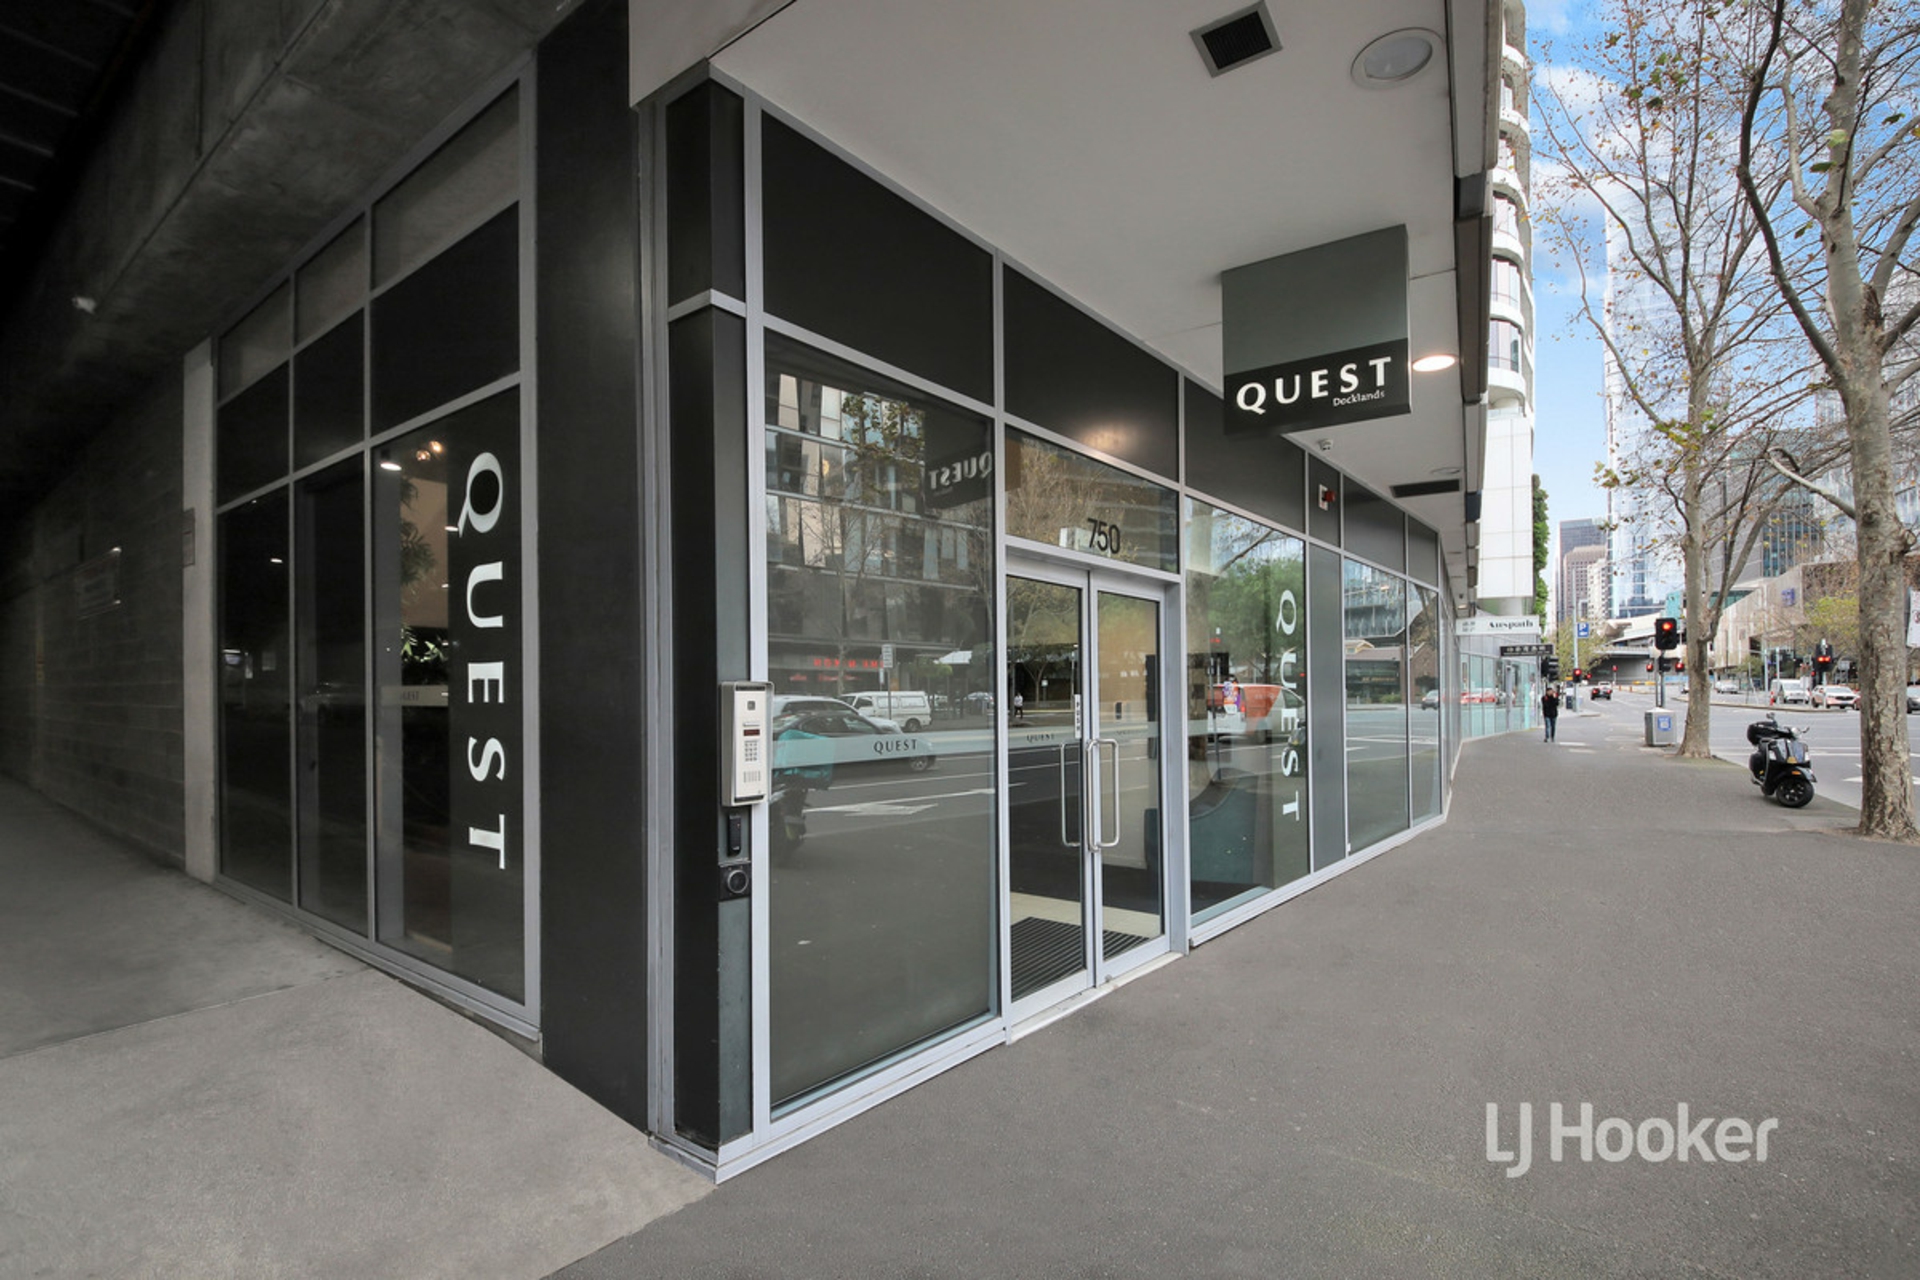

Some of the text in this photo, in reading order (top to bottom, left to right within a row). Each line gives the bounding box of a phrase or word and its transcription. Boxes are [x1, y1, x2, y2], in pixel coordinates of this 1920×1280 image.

[1236, 356, 1392, 415] QUEST
[1333, 389, 1386, 407] Docklands
[1087, 517, 1121, 555] 750
[457, 452, 506, 870] QUEST
[1276, 589, 1300, 821] QUEST
[873, 739, 918, 755] QUEST
